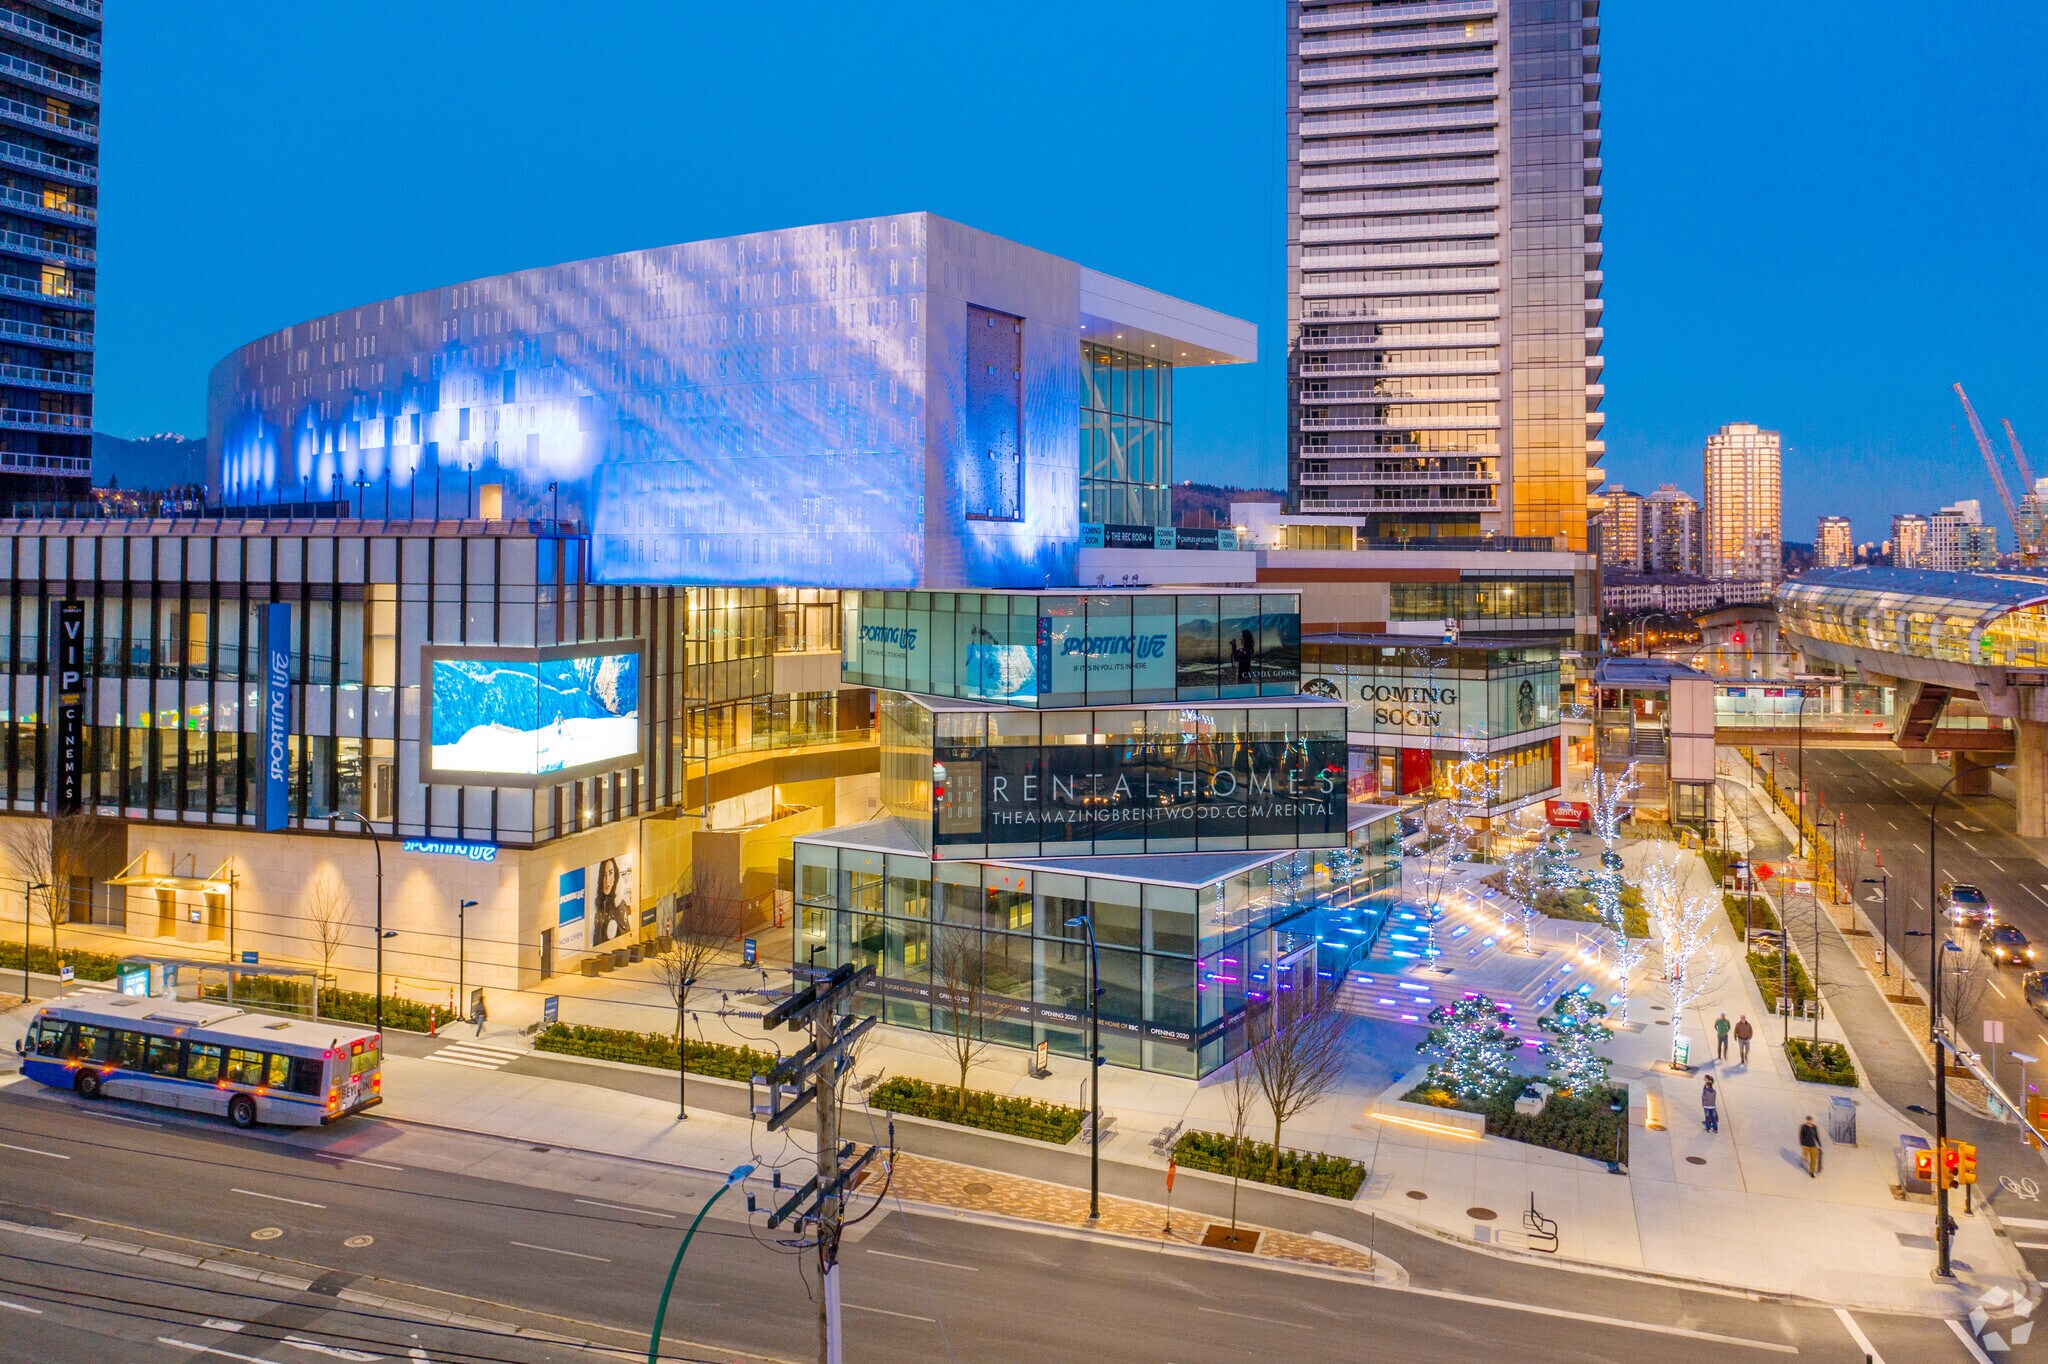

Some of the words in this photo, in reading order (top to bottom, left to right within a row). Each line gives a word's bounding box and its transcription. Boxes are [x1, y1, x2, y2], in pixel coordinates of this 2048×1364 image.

[1111, 532, 1121, 541] THE
[1122, 533, 1132, 542] REC
[1132, 533, 1147, 542] ROOM
[1157, 529, 1174, 538] COMING
[1220, 532, 1235, 540] COMING
[1084, 536, 1099, 545] SOON
[1159, 538, 1172, 547] SOON
[1222, 540, 1233, 548] SOON
[63, 621, 80, 690] VIP
[1360, 684, 1458, 706] COMING
[1375, 707, 1442, 727] SOON
[65, 709, 75, 799] CINEMAS
[993, 773, 1158, 802] RENTAL
[1178, 768, 1334, 797] HOMES
[1552, 807, 1582, 818] Vancity
[1040, 1009, 1065, 1019] OPENING
[1064, 1012, 1078, 1021] 2020
[1087, 1016, 1105, 1026] FURE
[1105, 1020, 1121, 1029] HOME
[1128, 1023, 1139, 1031] RBC
[1150, 1028, 1176, 1038] OPENING
[1175, 1031, 1190, 1040] 2020
